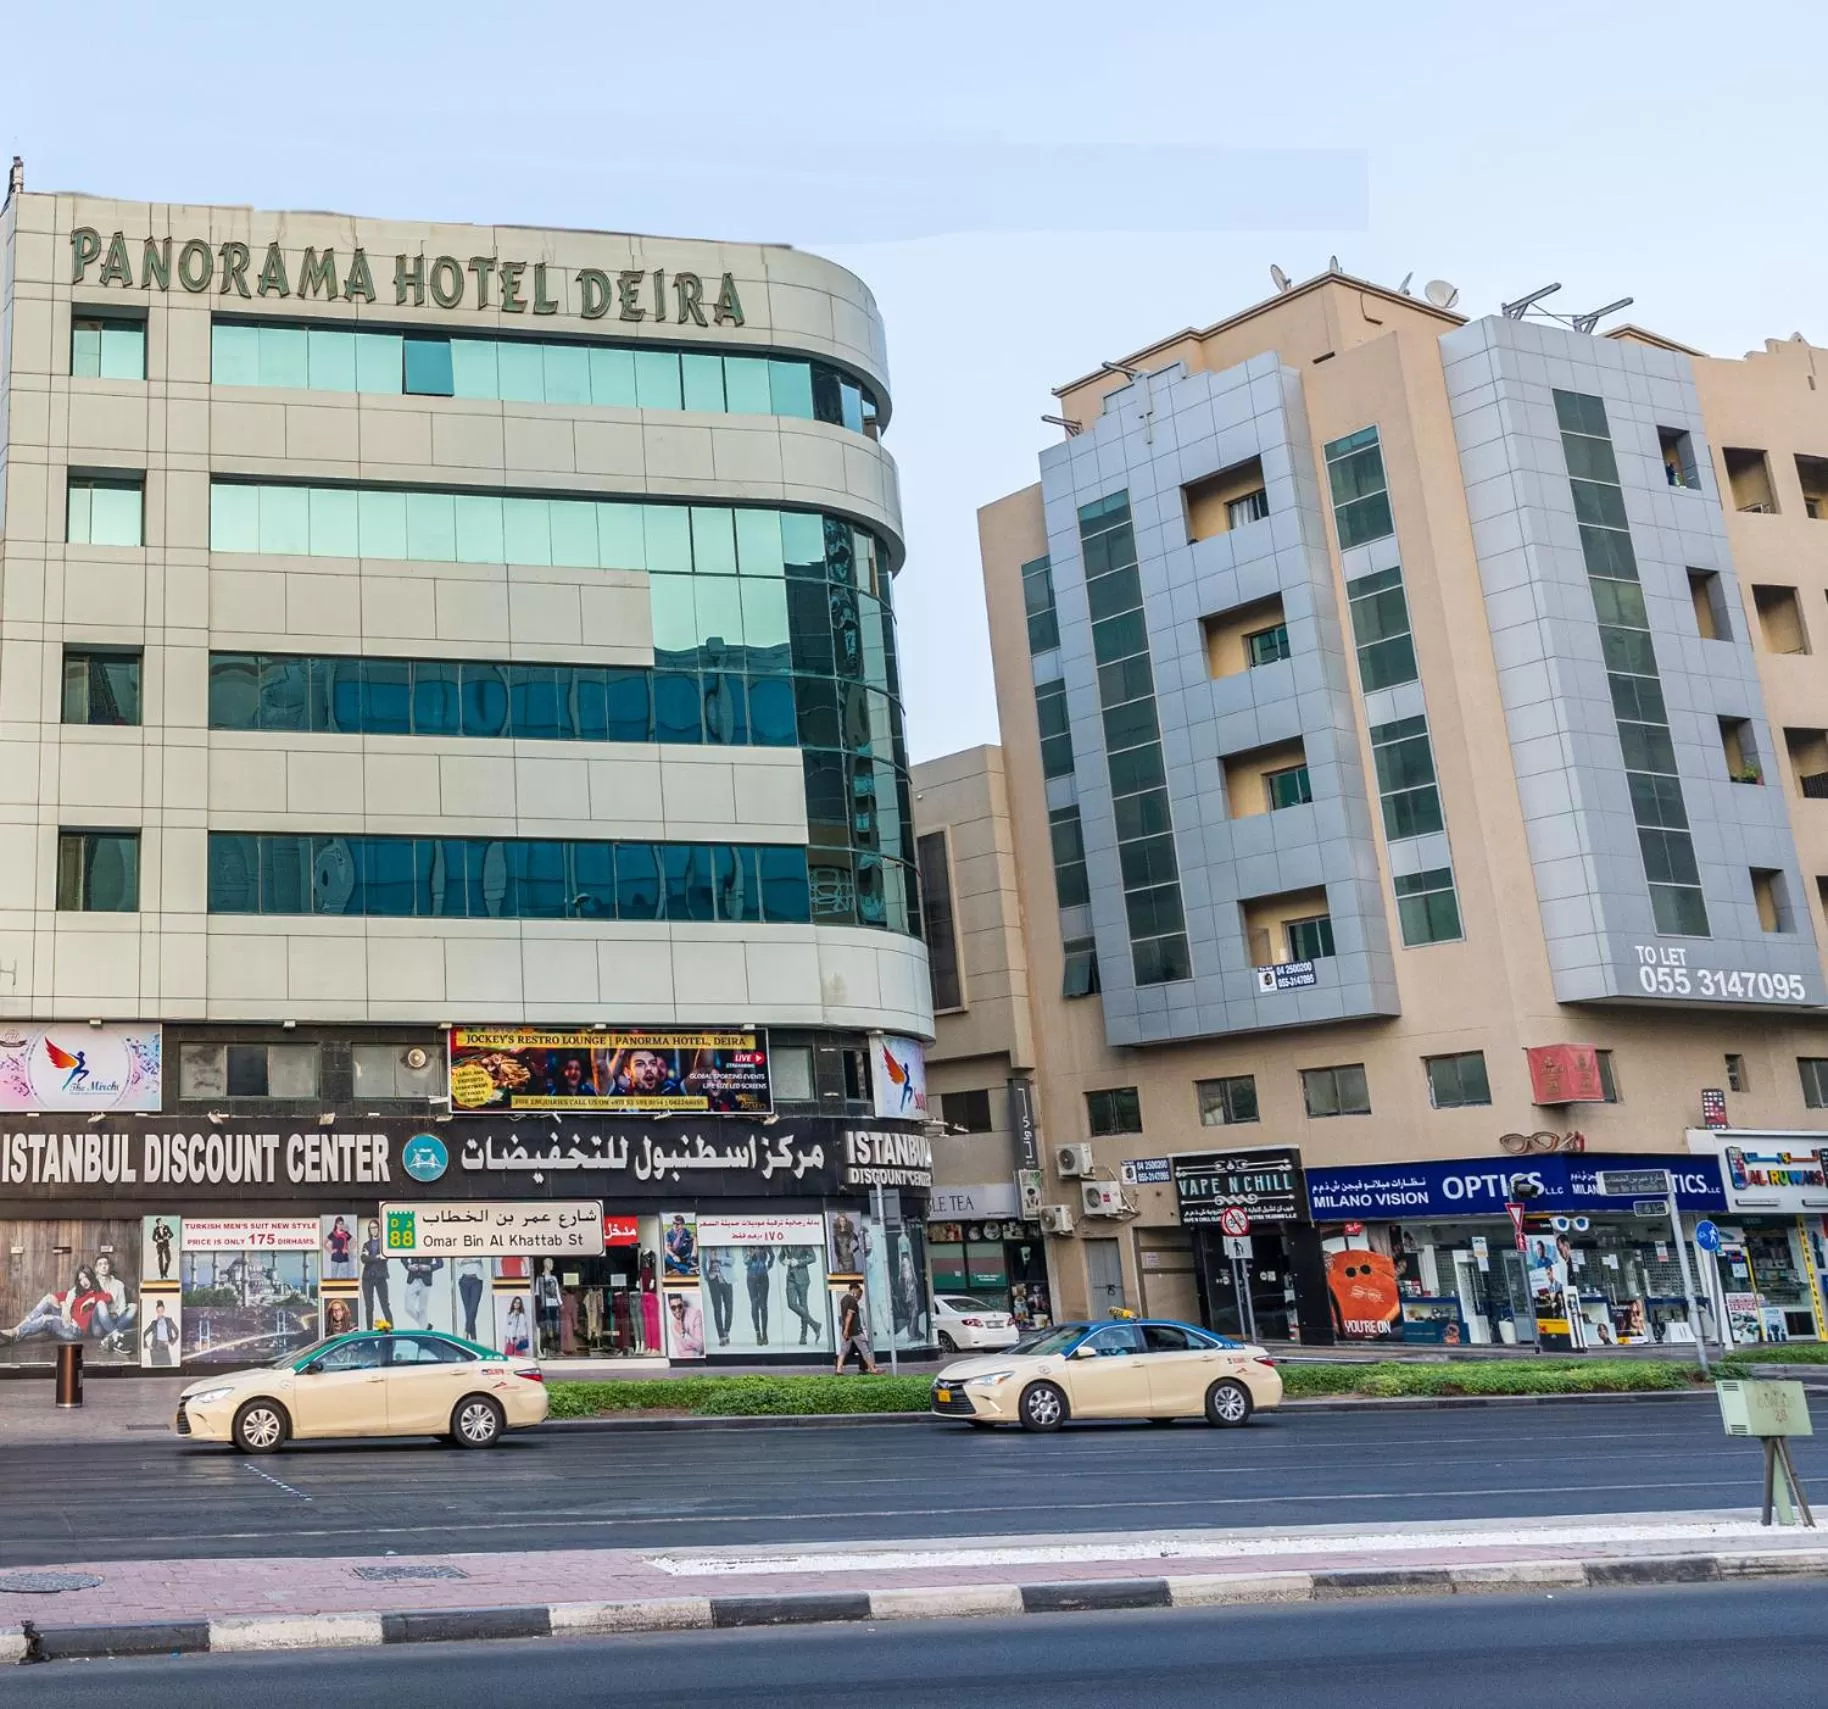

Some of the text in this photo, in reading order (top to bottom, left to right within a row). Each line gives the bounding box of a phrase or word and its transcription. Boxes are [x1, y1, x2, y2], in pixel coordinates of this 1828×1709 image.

[70, 226, 745, 328] PANORAMA HOTEL DEIRA
[1635, 945, 1687, 966] TO LET
[1640, 965, 1806, 1000] 055 3147095
[466, 1034, 514, 1045] JOCKEY'S
[517, 1035, 560, 1045] RESTRO
[562, 1035, 606, 1045] LOUNGE
[615, 1036, 669, 1046] PANORMA
[713, 1037, 746, 1046] DEIRA
[735, 1054, 752, 1062] LIVE
[460, 1132, 825, 1184] مركز اسطنبول للتخفيضات
[847, 1131, 933, 1168] ISTANBUL
[2, 1133, 391, 1184] ISTANBUL DISCOUNT CENTER
[850, 1167, 907, 1186] DISCOUNT
[1178, 1173, 1293, 1196] VAPE N CHILL
[949, 1195, 975, 1212] TEA
[1313, 1191, 1430, 1208] MILANO VISION
[184, 1222, 222, 1230] TURKISH
[223, 1222, 248, 1230] MEN'S
[422, 1208, 597, 1229] شارع عمر بن الخطاب
[187, 1238, 212, 1246] PRICE
[248, 1233, 276, 1245] 175
[389, 1230, 414, 1247] 88
[603, 1223, 637, 1240] مدخل
[764, 1231, 784, 1241] ١٧٥
[423, 1233, 584, 1248] Omar Bin Al Khattab St
[1344, 1319, 1392, 1334] YOU'RE ON
